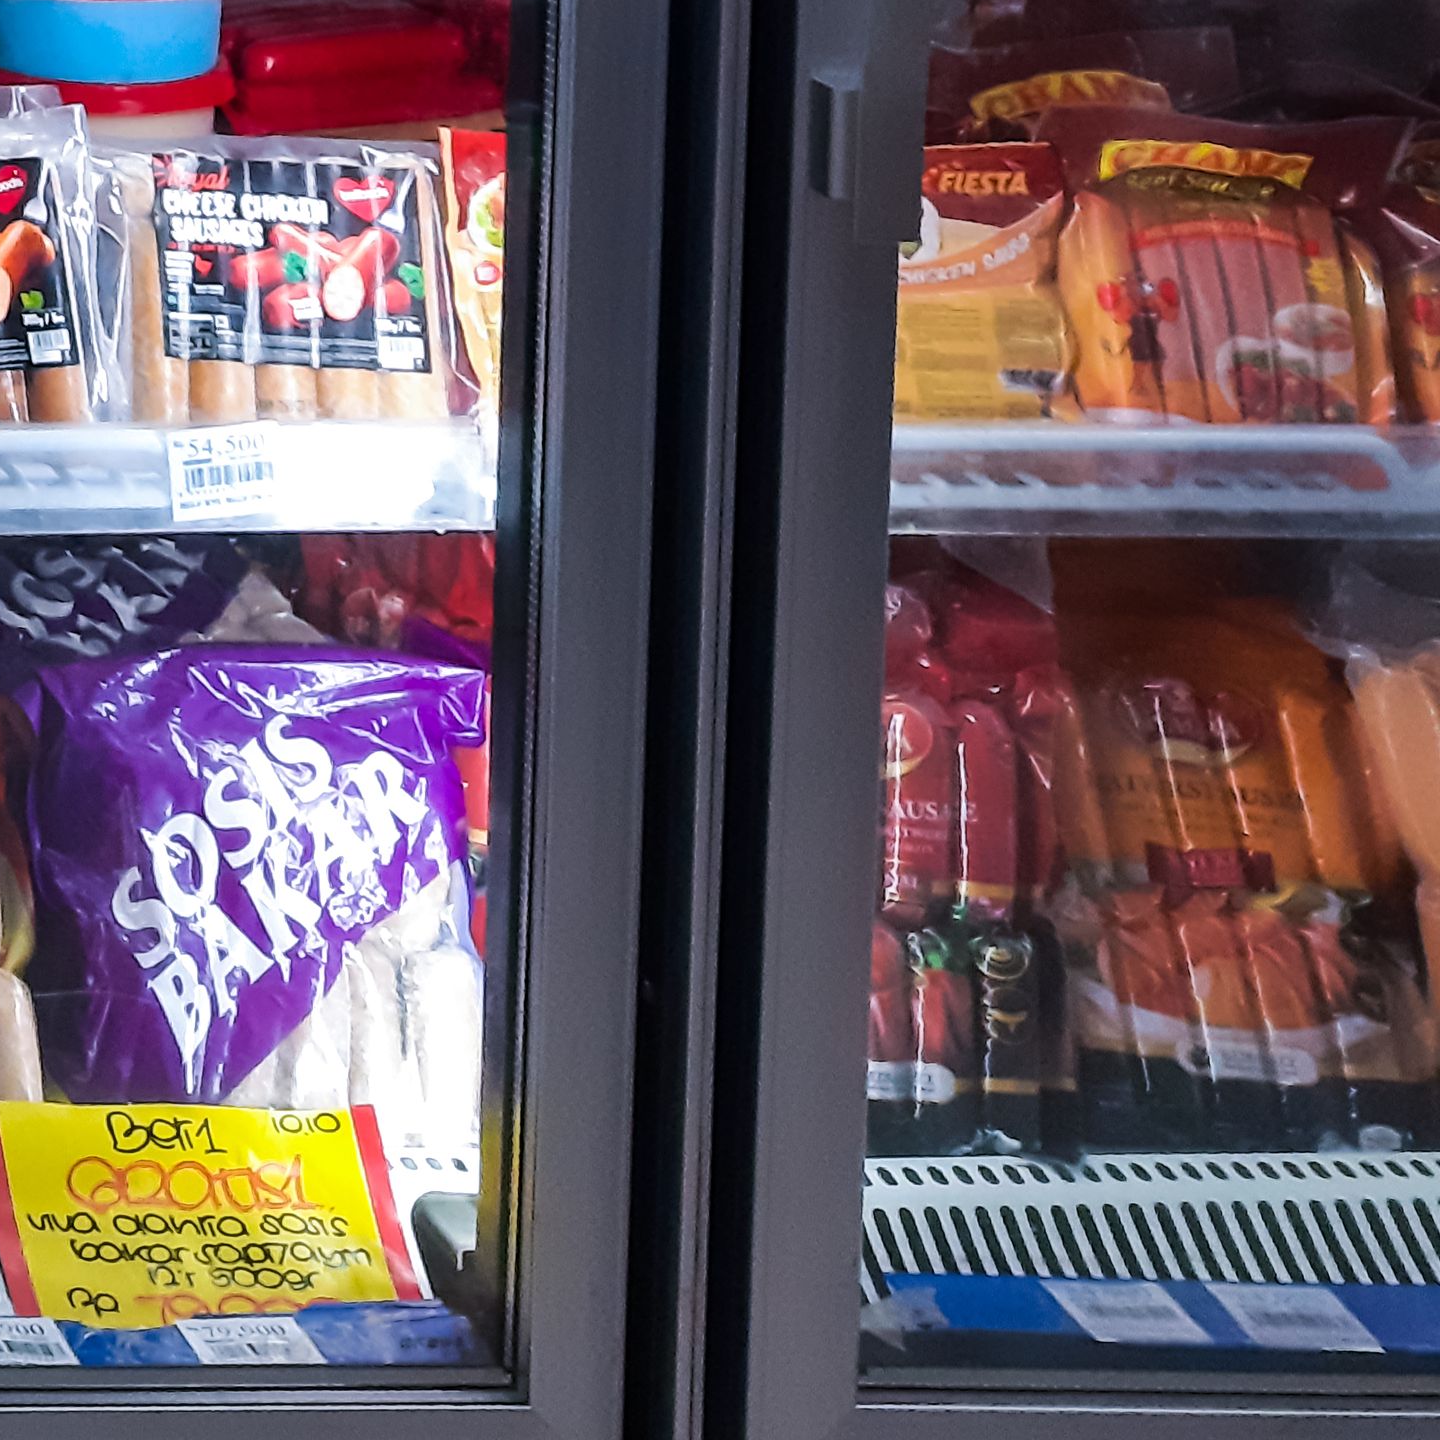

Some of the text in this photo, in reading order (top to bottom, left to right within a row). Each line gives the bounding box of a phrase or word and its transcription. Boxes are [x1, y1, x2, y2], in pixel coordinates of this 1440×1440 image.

[938, 170, 1029, 197] FIESTA
[186, 432, 264, 460] 54,500
[111, 714, 334, 971] SOSIS
[147, 750, 431, 1090] BAKAR
